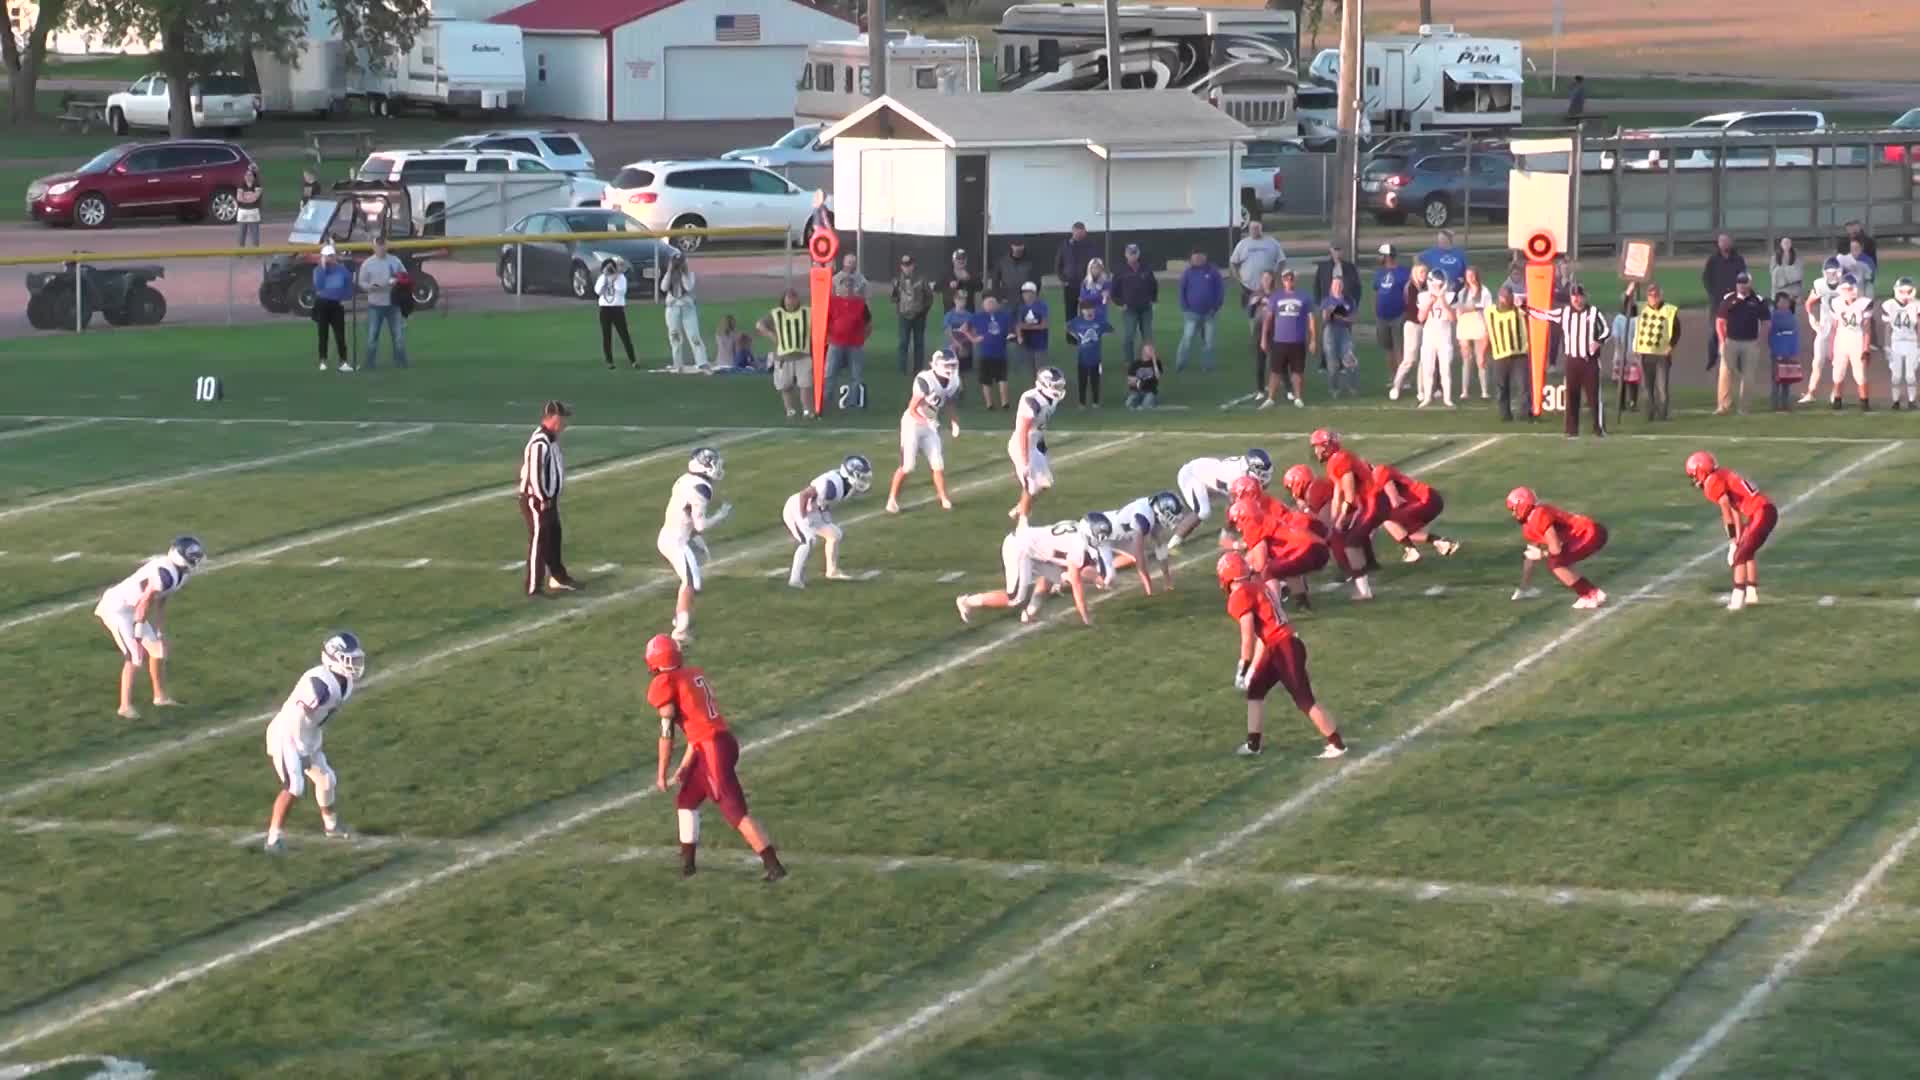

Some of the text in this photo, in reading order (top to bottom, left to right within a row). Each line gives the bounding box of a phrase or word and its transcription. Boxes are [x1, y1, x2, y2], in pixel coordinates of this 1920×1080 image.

[1456, 51, 1500, 64] PUMA
[1841, 312, 1857, 328] 54
[1894, 310, 1911, 329] 44
[196, 375, 215, 401] 10
[1542, 384, 1567, 411] 30
